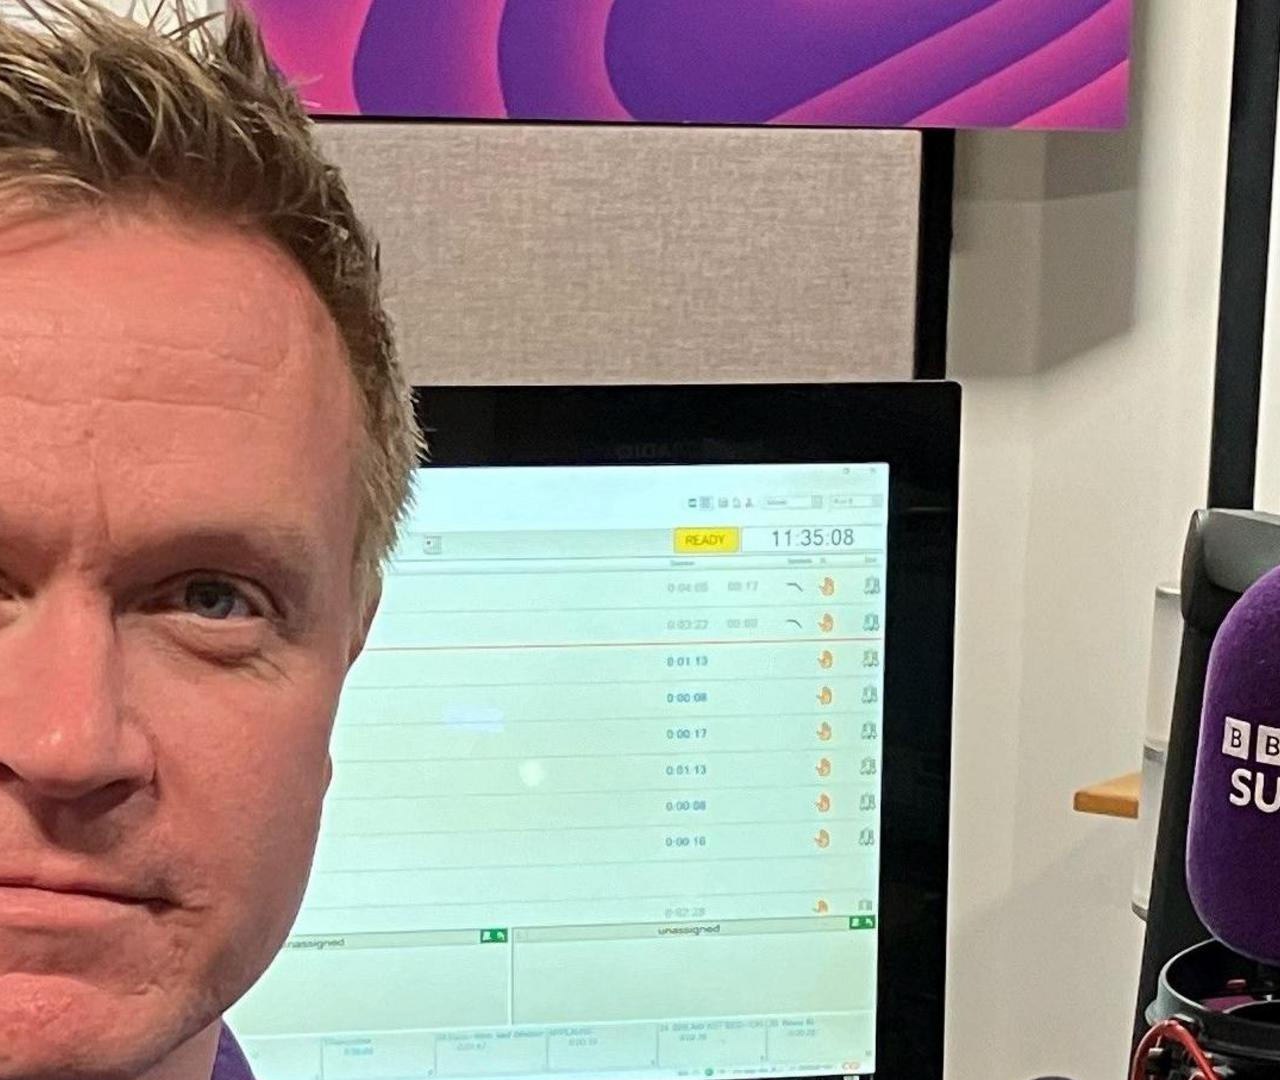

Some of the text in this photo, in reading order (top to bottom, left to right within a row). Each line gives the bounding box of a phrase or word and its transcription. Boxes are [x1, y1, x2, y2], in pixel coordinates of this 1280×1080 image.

[684, 528, 854, 547] READY 11:35:08
[657, 924, 720, 936] unassigned
[286, 938, 345, 950] nassigned
